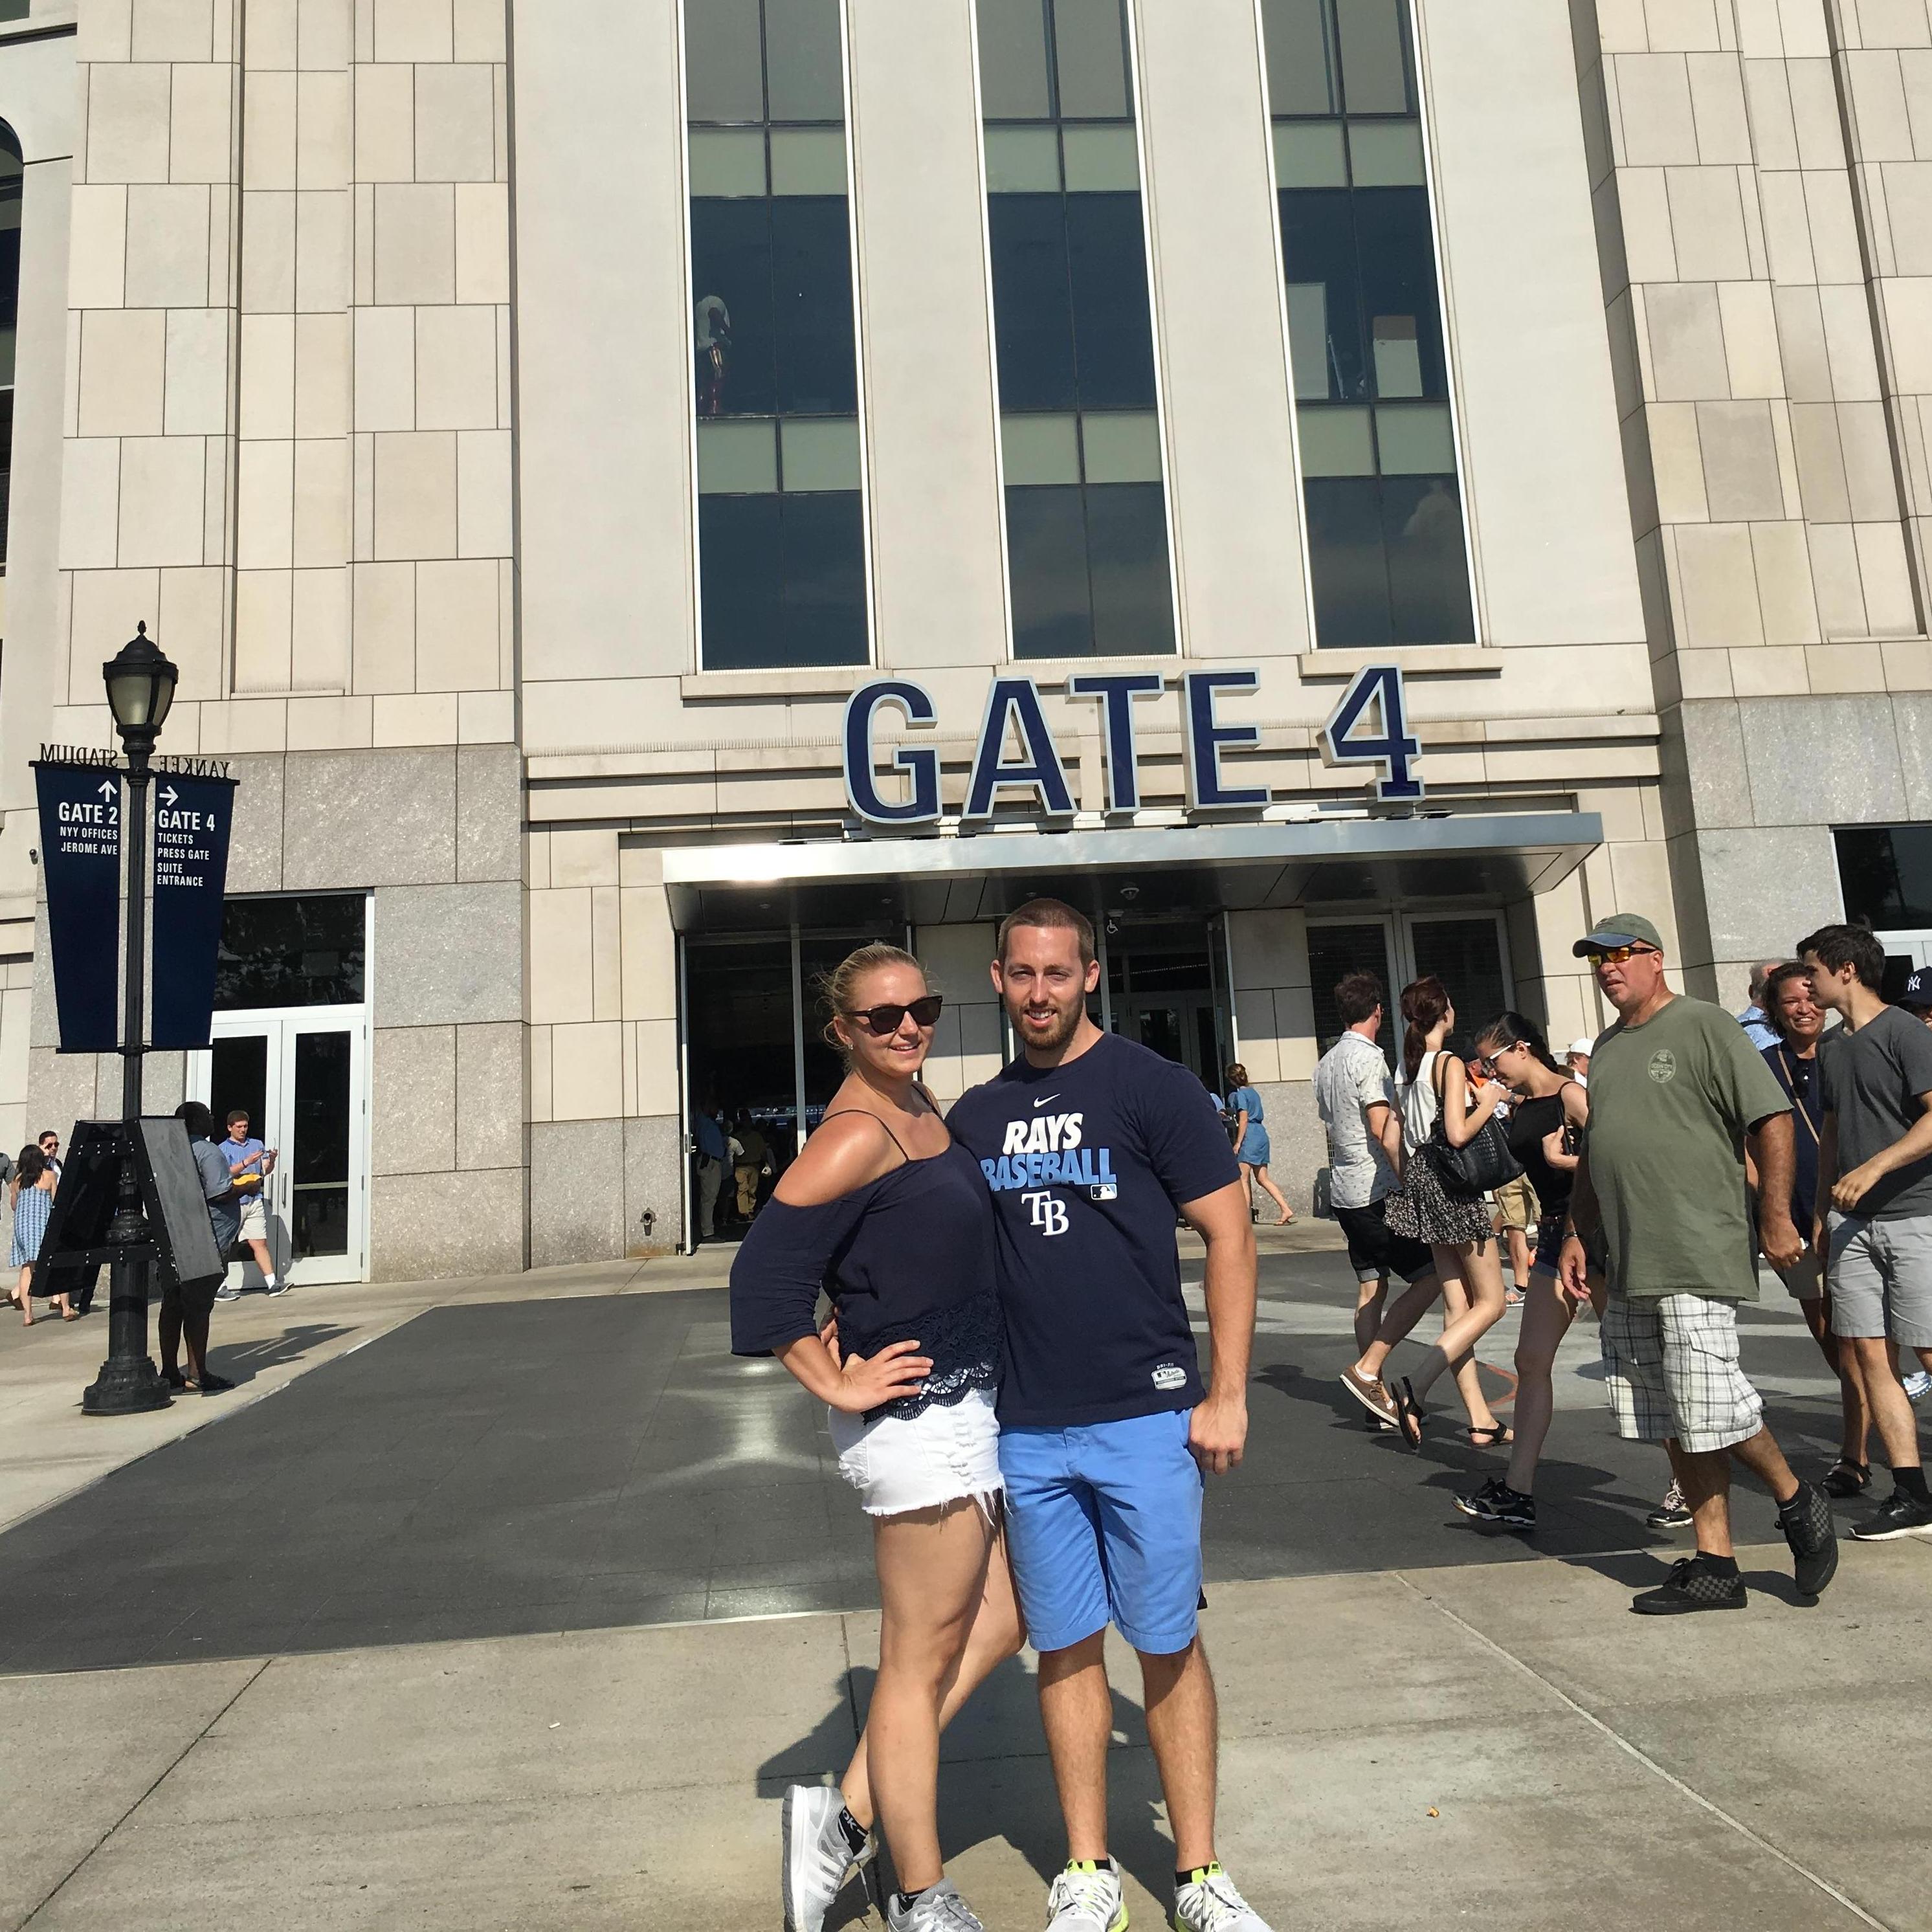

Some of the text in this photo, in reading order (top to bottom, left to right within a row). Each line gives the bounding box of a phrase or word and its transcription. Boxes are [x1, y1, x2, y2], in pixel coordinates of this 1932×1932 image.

[843, 663, 1425, 824] GATE 4
[58, 802, 118, 825] GATE 2
[158, 809, 216, 832] GATE 4
[60, 827, 118, 840] NYY OFFICES
[158, 832, 194, 845] TICKETS
[61, 841, 118, 855] JEROME AVE
[157, 848, 210, 861] PRESS GATE
[157, 862, 183, 874] SUITE
[157, 875, 203, 887] ENTRANCE
[1907, 975, 1921, 992] NY
[1002, 1112, 1084, 1156] RAYS
[980, 1148, 1117, 1192] BASEBALL
[1021, 1190, 1069, 1237] TB
